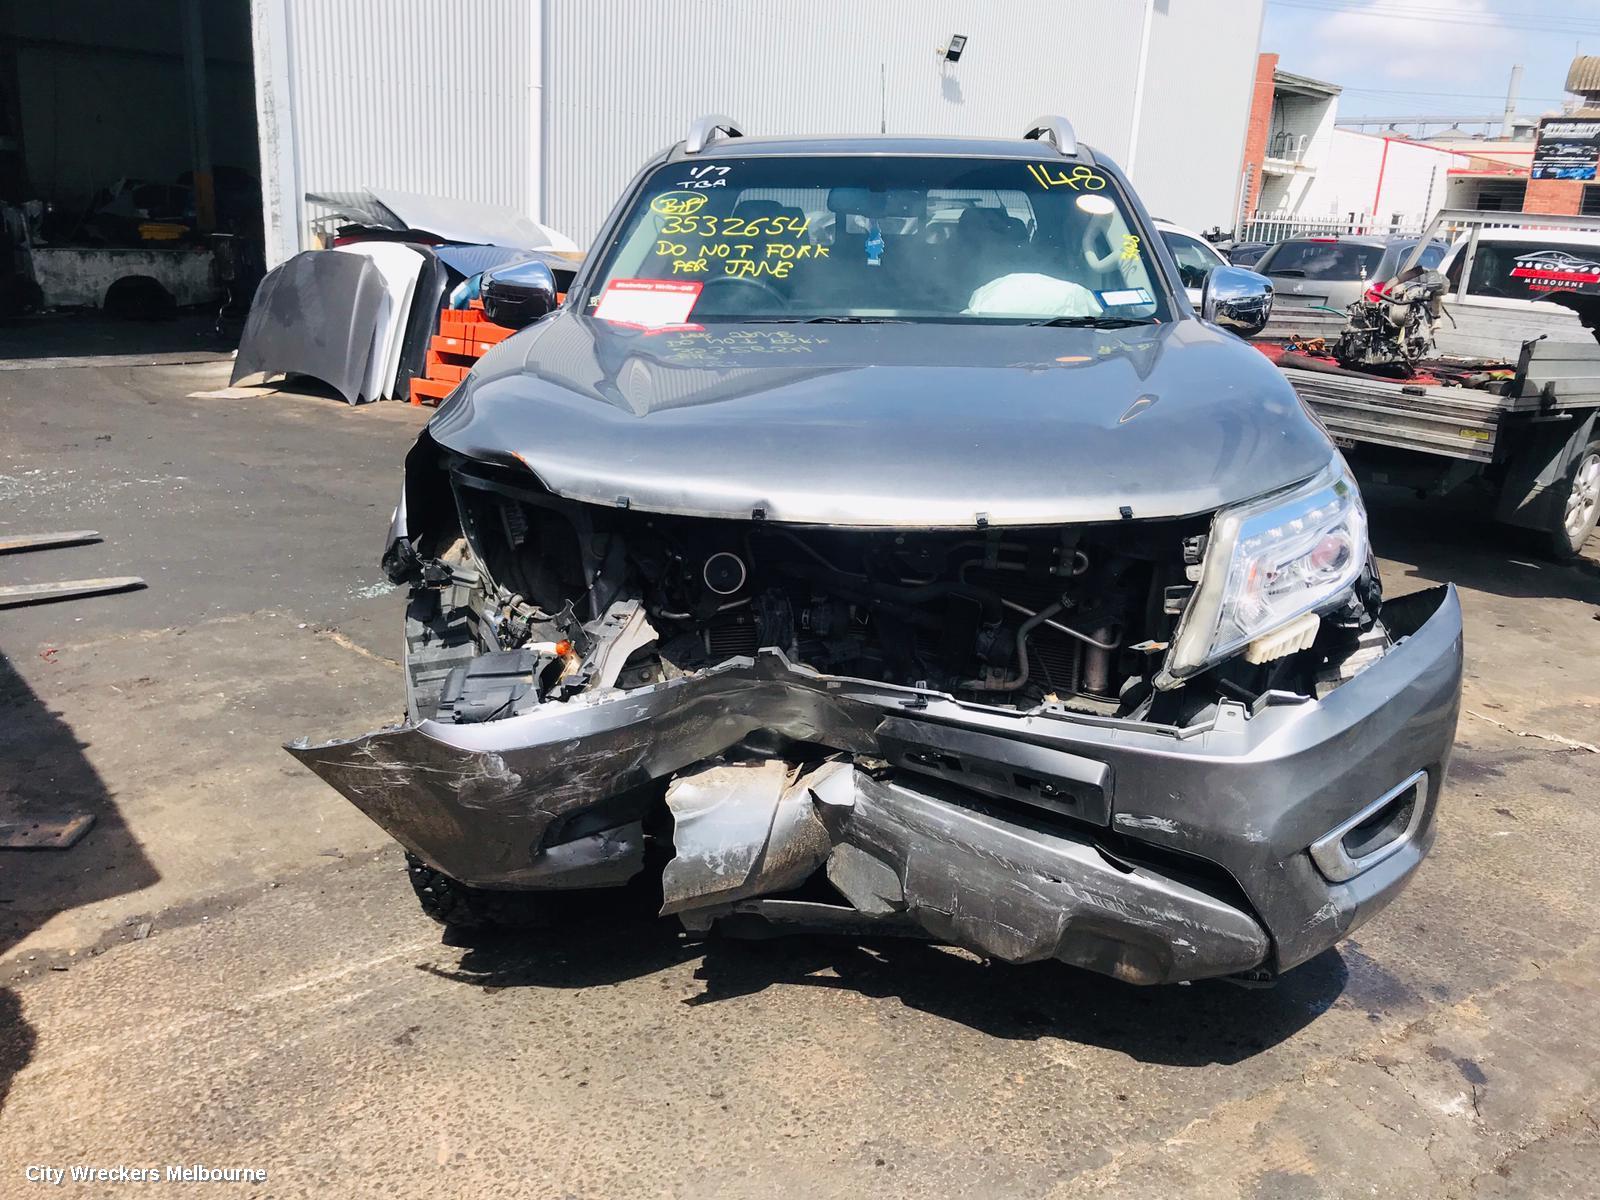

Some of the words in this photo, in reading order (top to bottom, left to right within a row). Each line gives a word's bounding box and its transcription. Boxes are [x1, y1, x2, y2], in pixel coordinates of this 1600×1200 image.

[690, 165, 732, 179] 1/7
[1027, 163, 1106, 191] 148
[676, 179, 727, 189] TBA
[661, 215, 811, 239] 3532654
[656, 240, 688, 256] DO
[699, 243, 754, 258] NOT
[766, 244, 830, 259] FORK
[672, 258, 710, 274] PER
[724, 260, 794, 278] JANE
[1524, 278, 1584, 288] MELBOURNE
